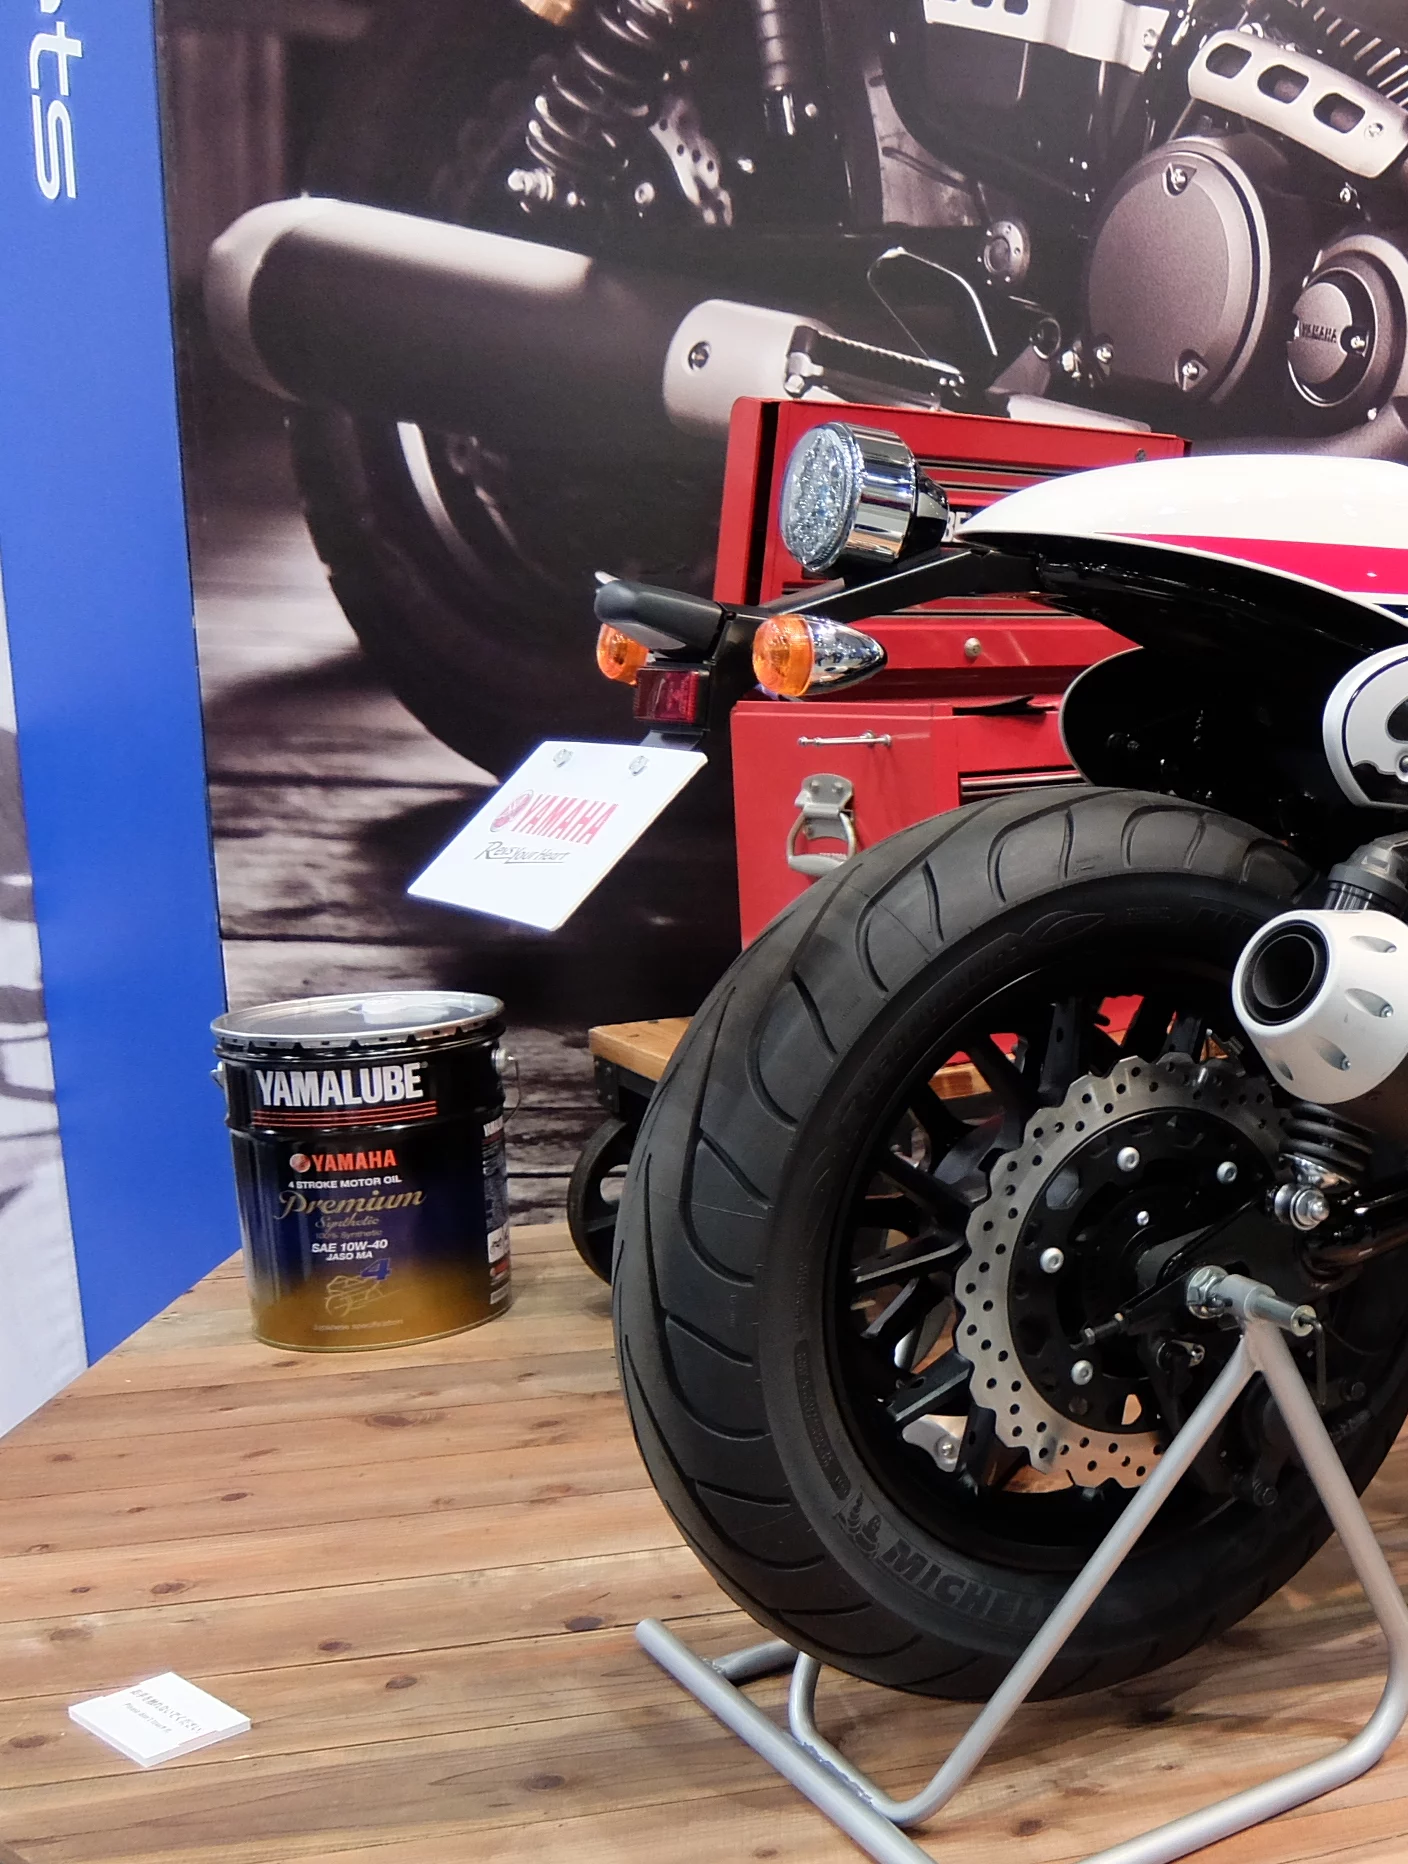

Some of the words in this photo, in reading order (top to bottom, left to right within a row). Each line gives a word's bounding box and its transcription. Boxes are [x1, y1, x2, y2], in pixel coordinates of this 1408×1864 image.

[29, 0, 82, 200] ts
[511, 793, 619, 845] YAMAHA
[254, 1061, 425, 1107] YAMALUBE
[311, 1149, 398, 1172] YAMAHA
[296, 1179, 338, 1189] STROKE
[340, 1177, 382, 1188] MOTOR
[383, 1175, 402, 1184] OIL
[273, 1190, 427, 1221] Premium
[315, 1212, 380, 1234] Synthetic
[311, 1242, 337, 1253] SAE
[340, 1239, 389, 1252] 10W-40
[326, 1252, 354, 1261] JASO
[356, 1251, 373, 1260] MA
